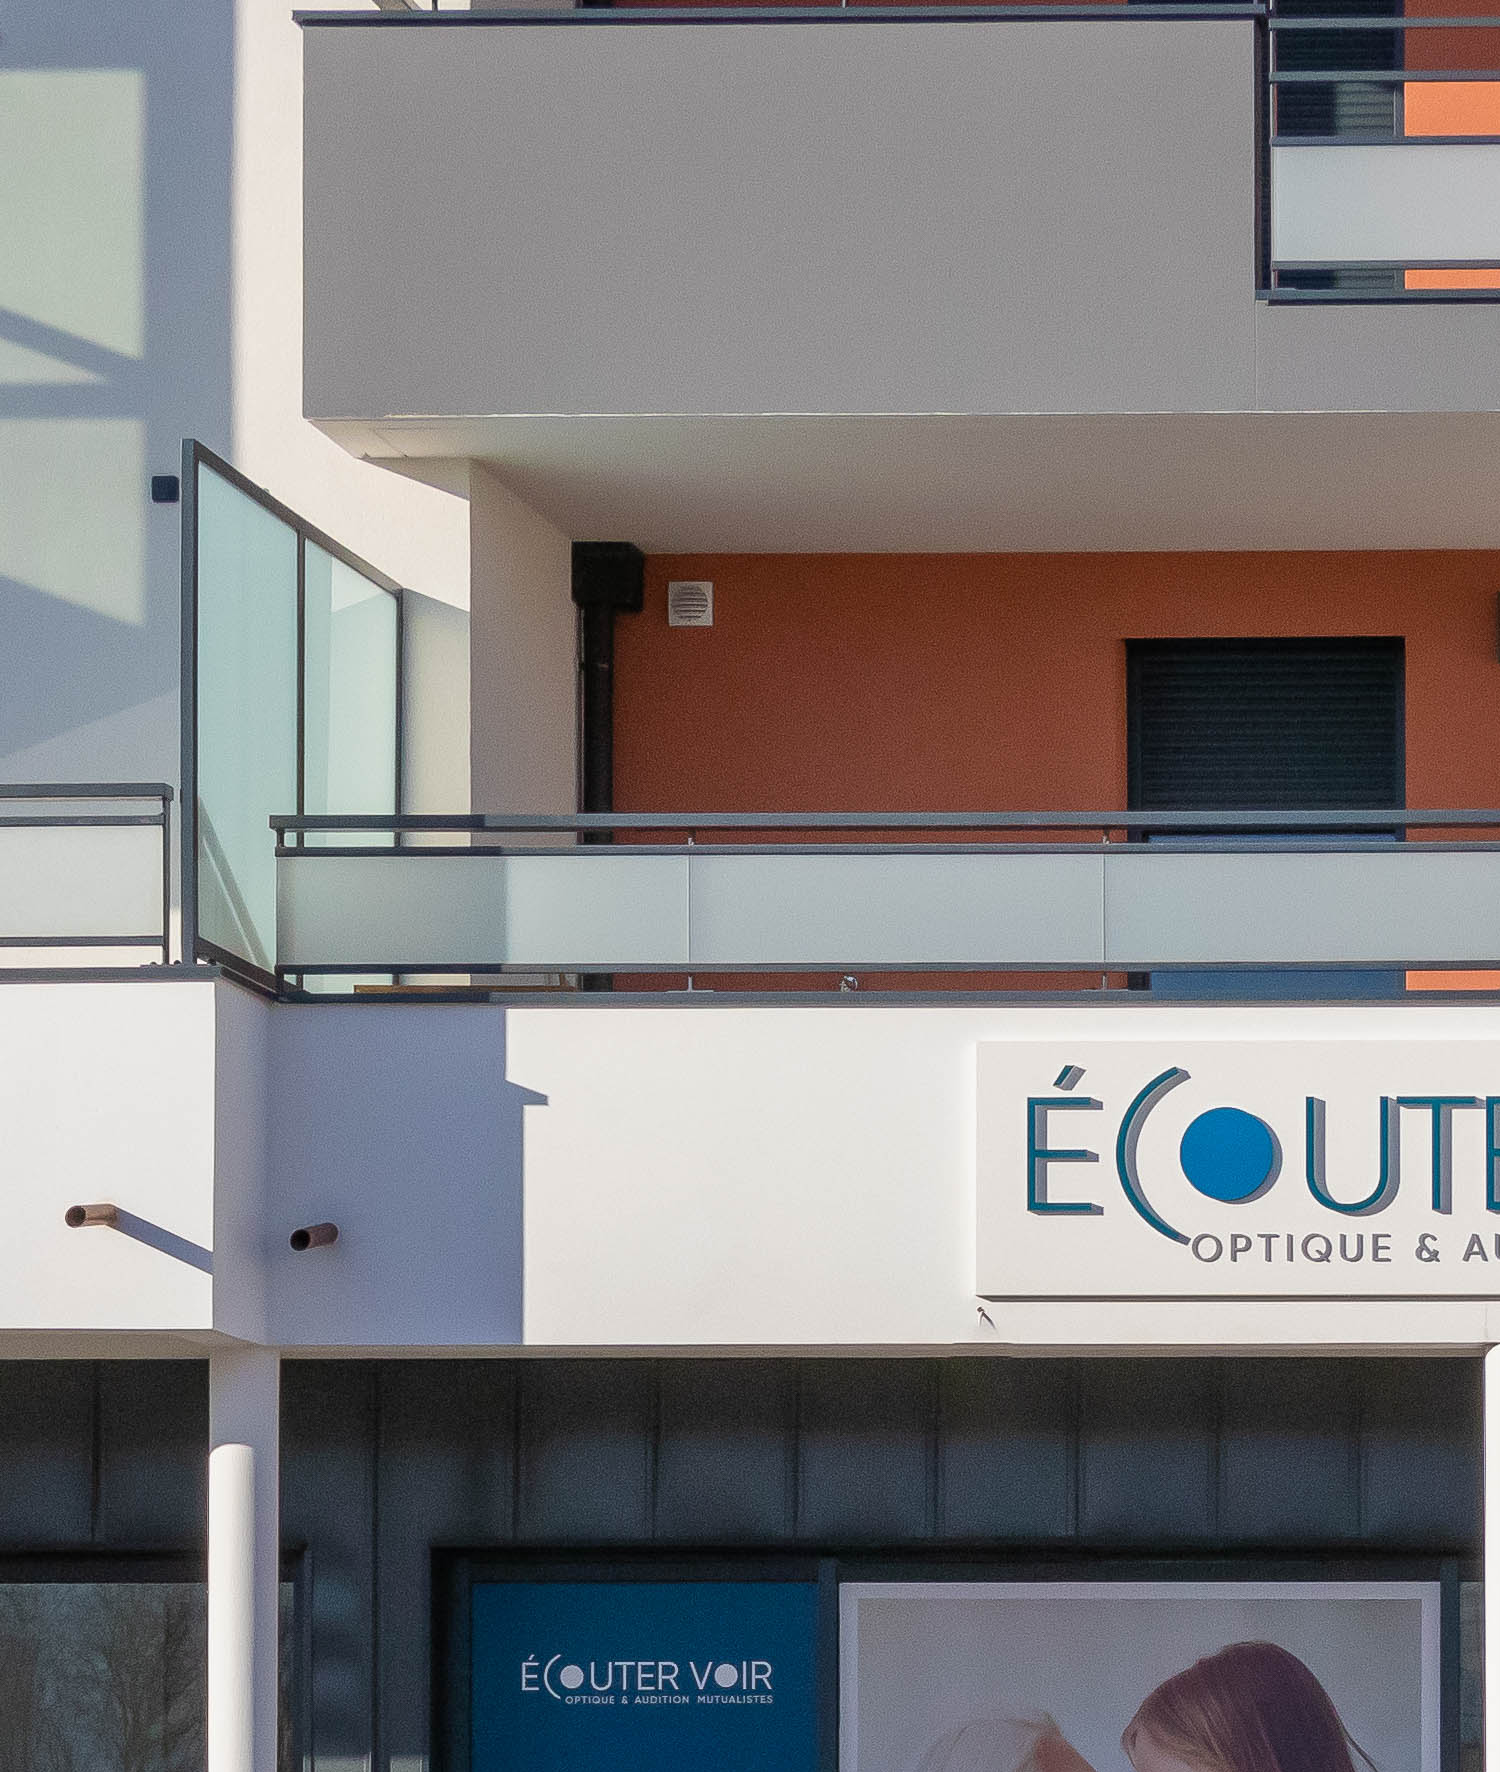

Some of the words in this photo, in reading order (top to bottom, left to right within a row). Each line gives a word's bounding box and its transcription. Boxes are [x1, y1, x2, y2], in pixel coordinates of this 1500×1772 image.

[1190, 1231, 1394, 1265] OPTIQUE
[1415, 1231, 1441, 1264] &
[520, 1653, 680, 1700] ÉCOUTER
[689, 1661, 774, 1691] VOIR
[565, 1695, 616, 1705] OPTIQUE
[621, 1695, 629, 1704] &
[634, 1695, 690, 1704] AUDITION
[697, 1694, 774, 1704] MUTUALISTES
